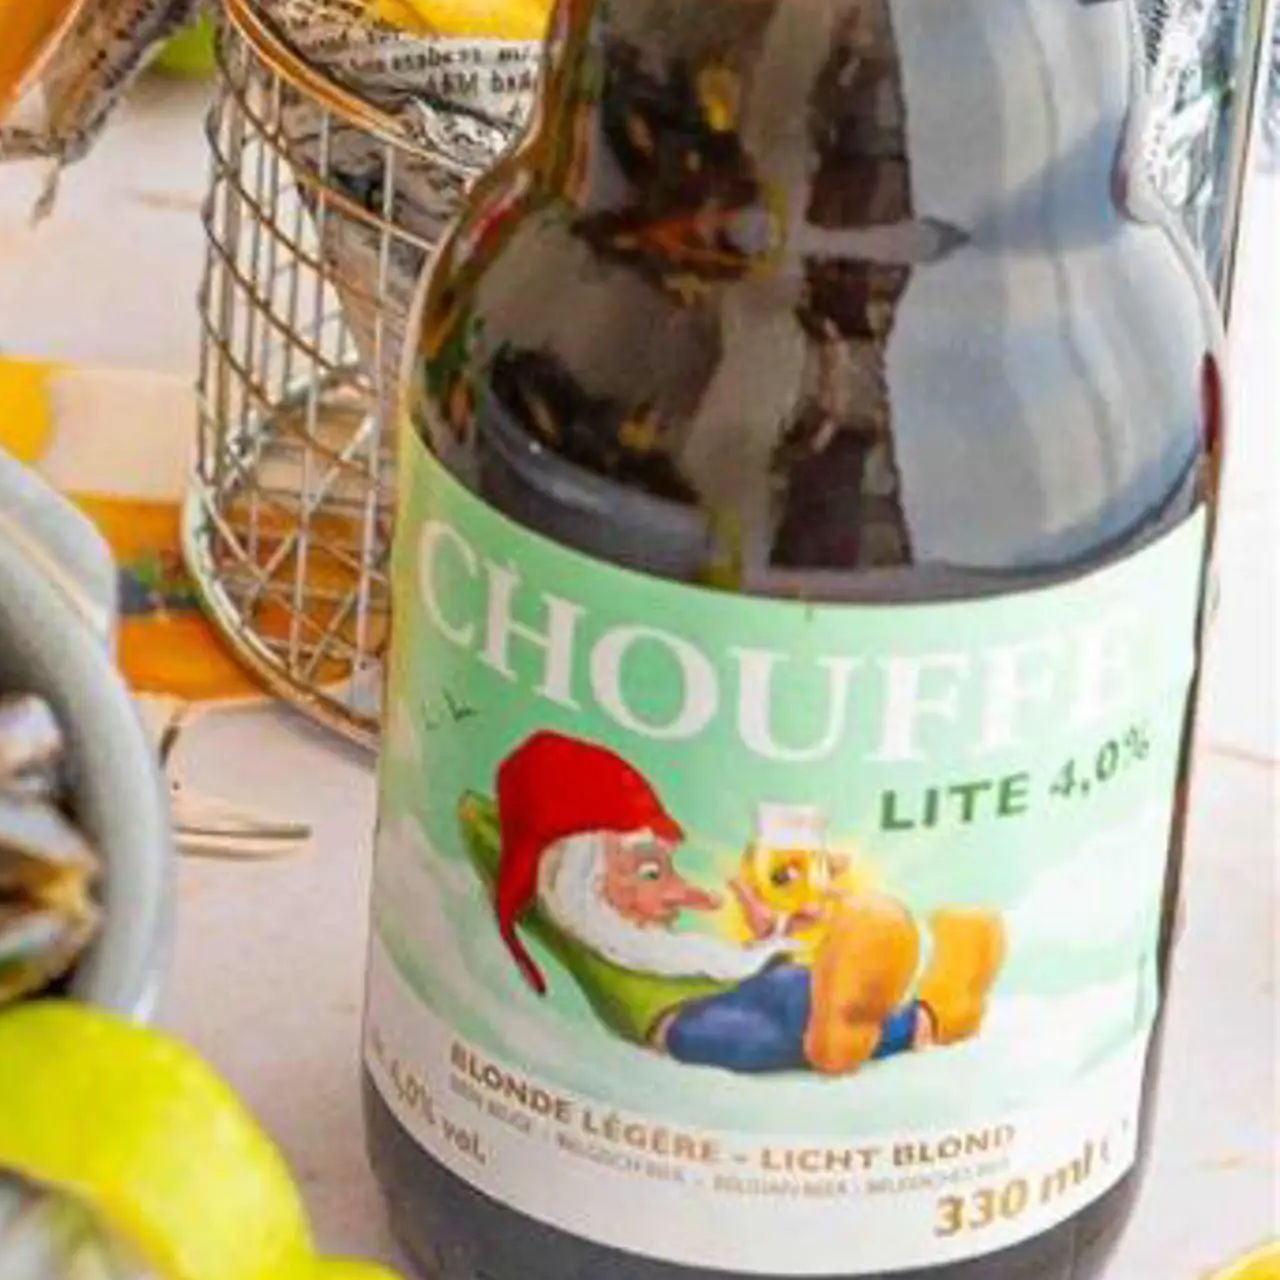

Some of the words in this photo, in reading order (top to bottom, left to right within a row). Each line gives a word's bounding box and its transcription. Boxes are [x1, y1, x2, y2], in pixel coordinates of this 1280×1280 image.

[418, 518, 1134, 763] CHOUFFE
[880, 771, 1031, 832] LITE
[451, 1040, 576, 1124] BLONDE
[760, 1146, 880, 1172] LICHT
[893, 1123, 1016, 1169] BLOND
[933, 1177, 1031, 1238] 330
[1040, 1137, 1095, 1205] ml
